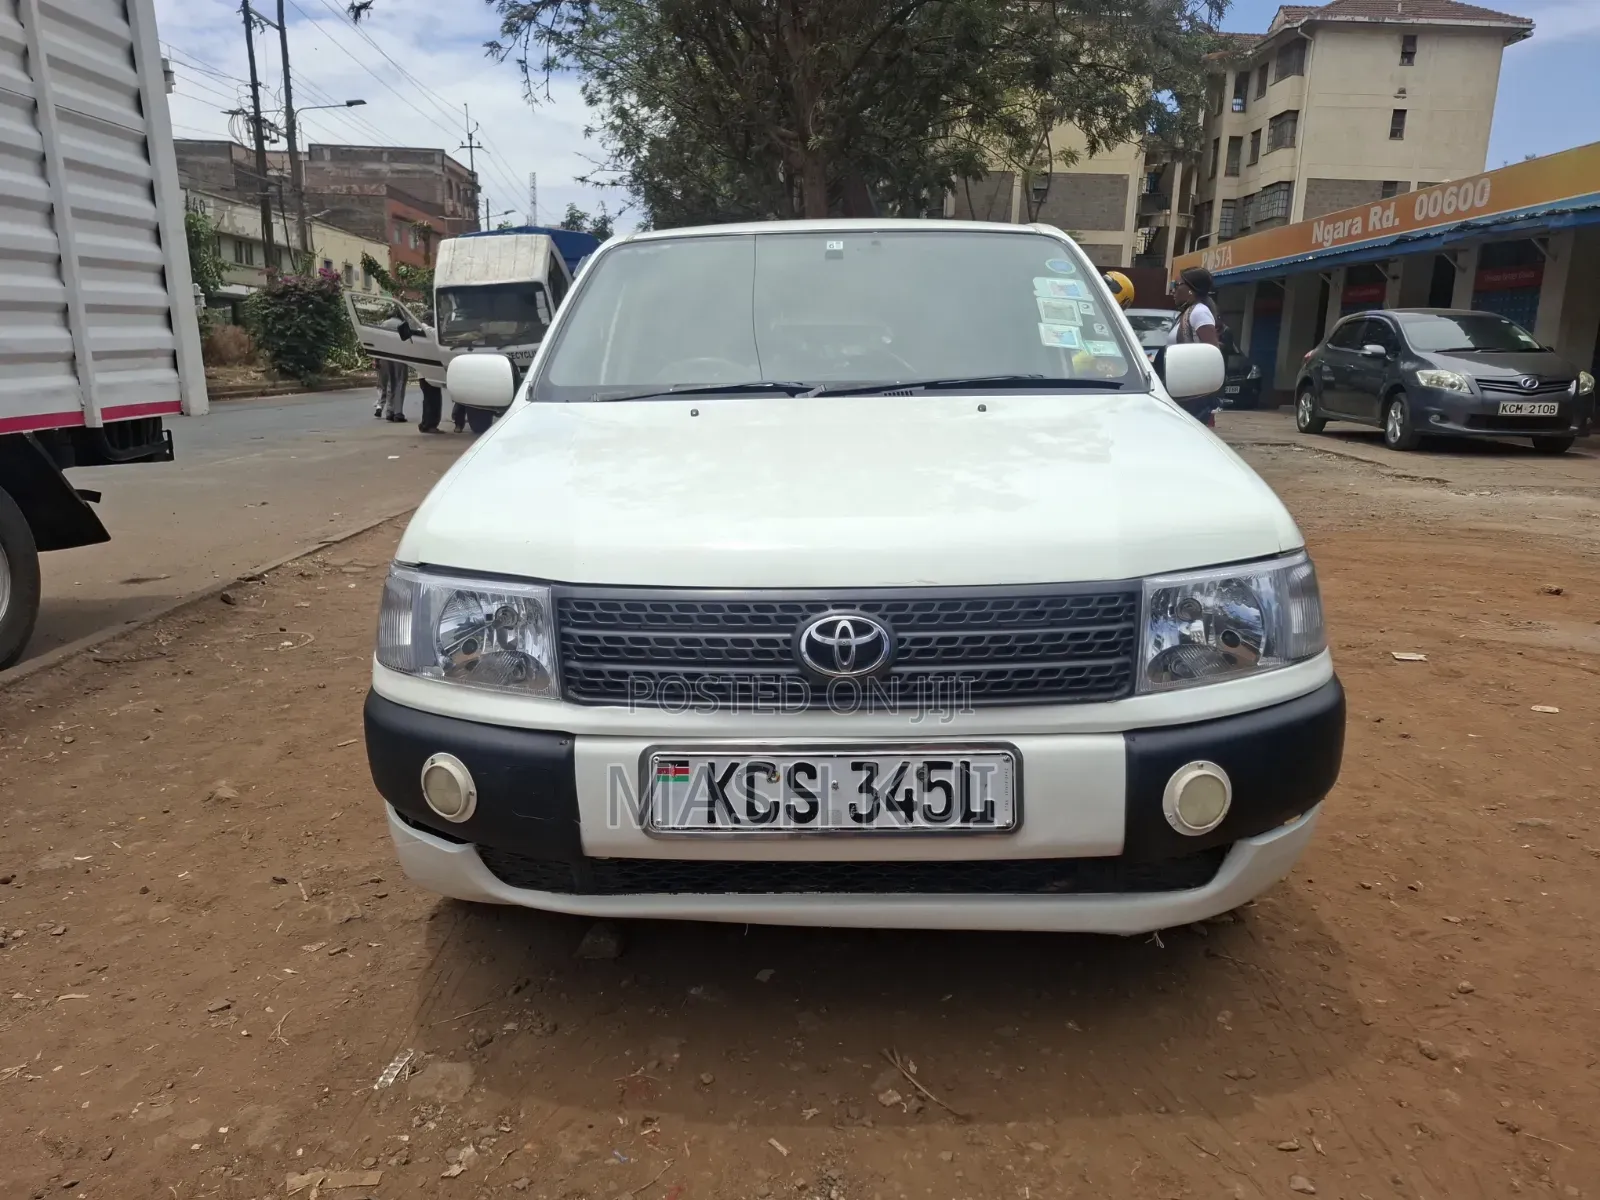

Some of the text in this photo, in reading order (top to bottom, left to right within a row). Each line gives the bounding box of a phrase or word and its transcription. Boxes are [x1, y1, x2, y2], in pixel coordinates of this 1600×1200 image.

[1311, 177, 1491, 247] Ngara Rd. 00600
[1201, 245, 1232, 269] POSTA
[1501, 403, 1523, 414] KCM
[706, 760, 820, 825] KCS
[848, 760, 996, 825] 345L
